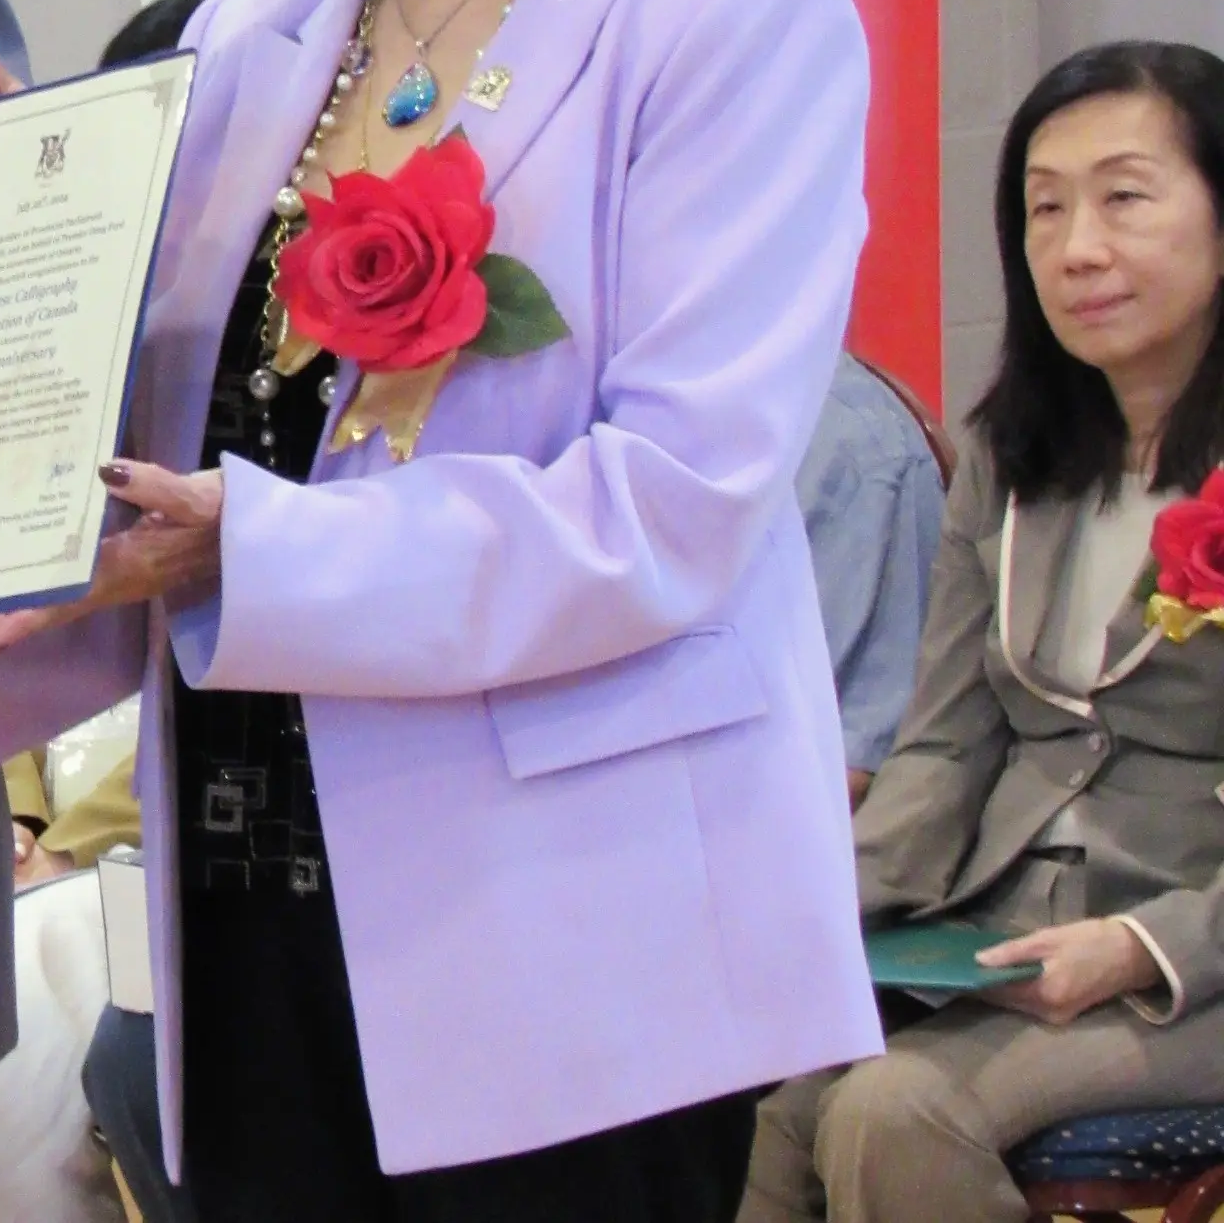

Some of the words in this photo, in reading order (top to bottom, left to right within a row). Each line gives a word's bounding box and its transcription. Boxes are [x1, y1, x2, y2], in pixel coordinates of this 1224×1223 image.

[14, 277, 78, 302] Calligraphy
[24, 310, 38, 327] of
[38, 299, 78, 322] Canada
